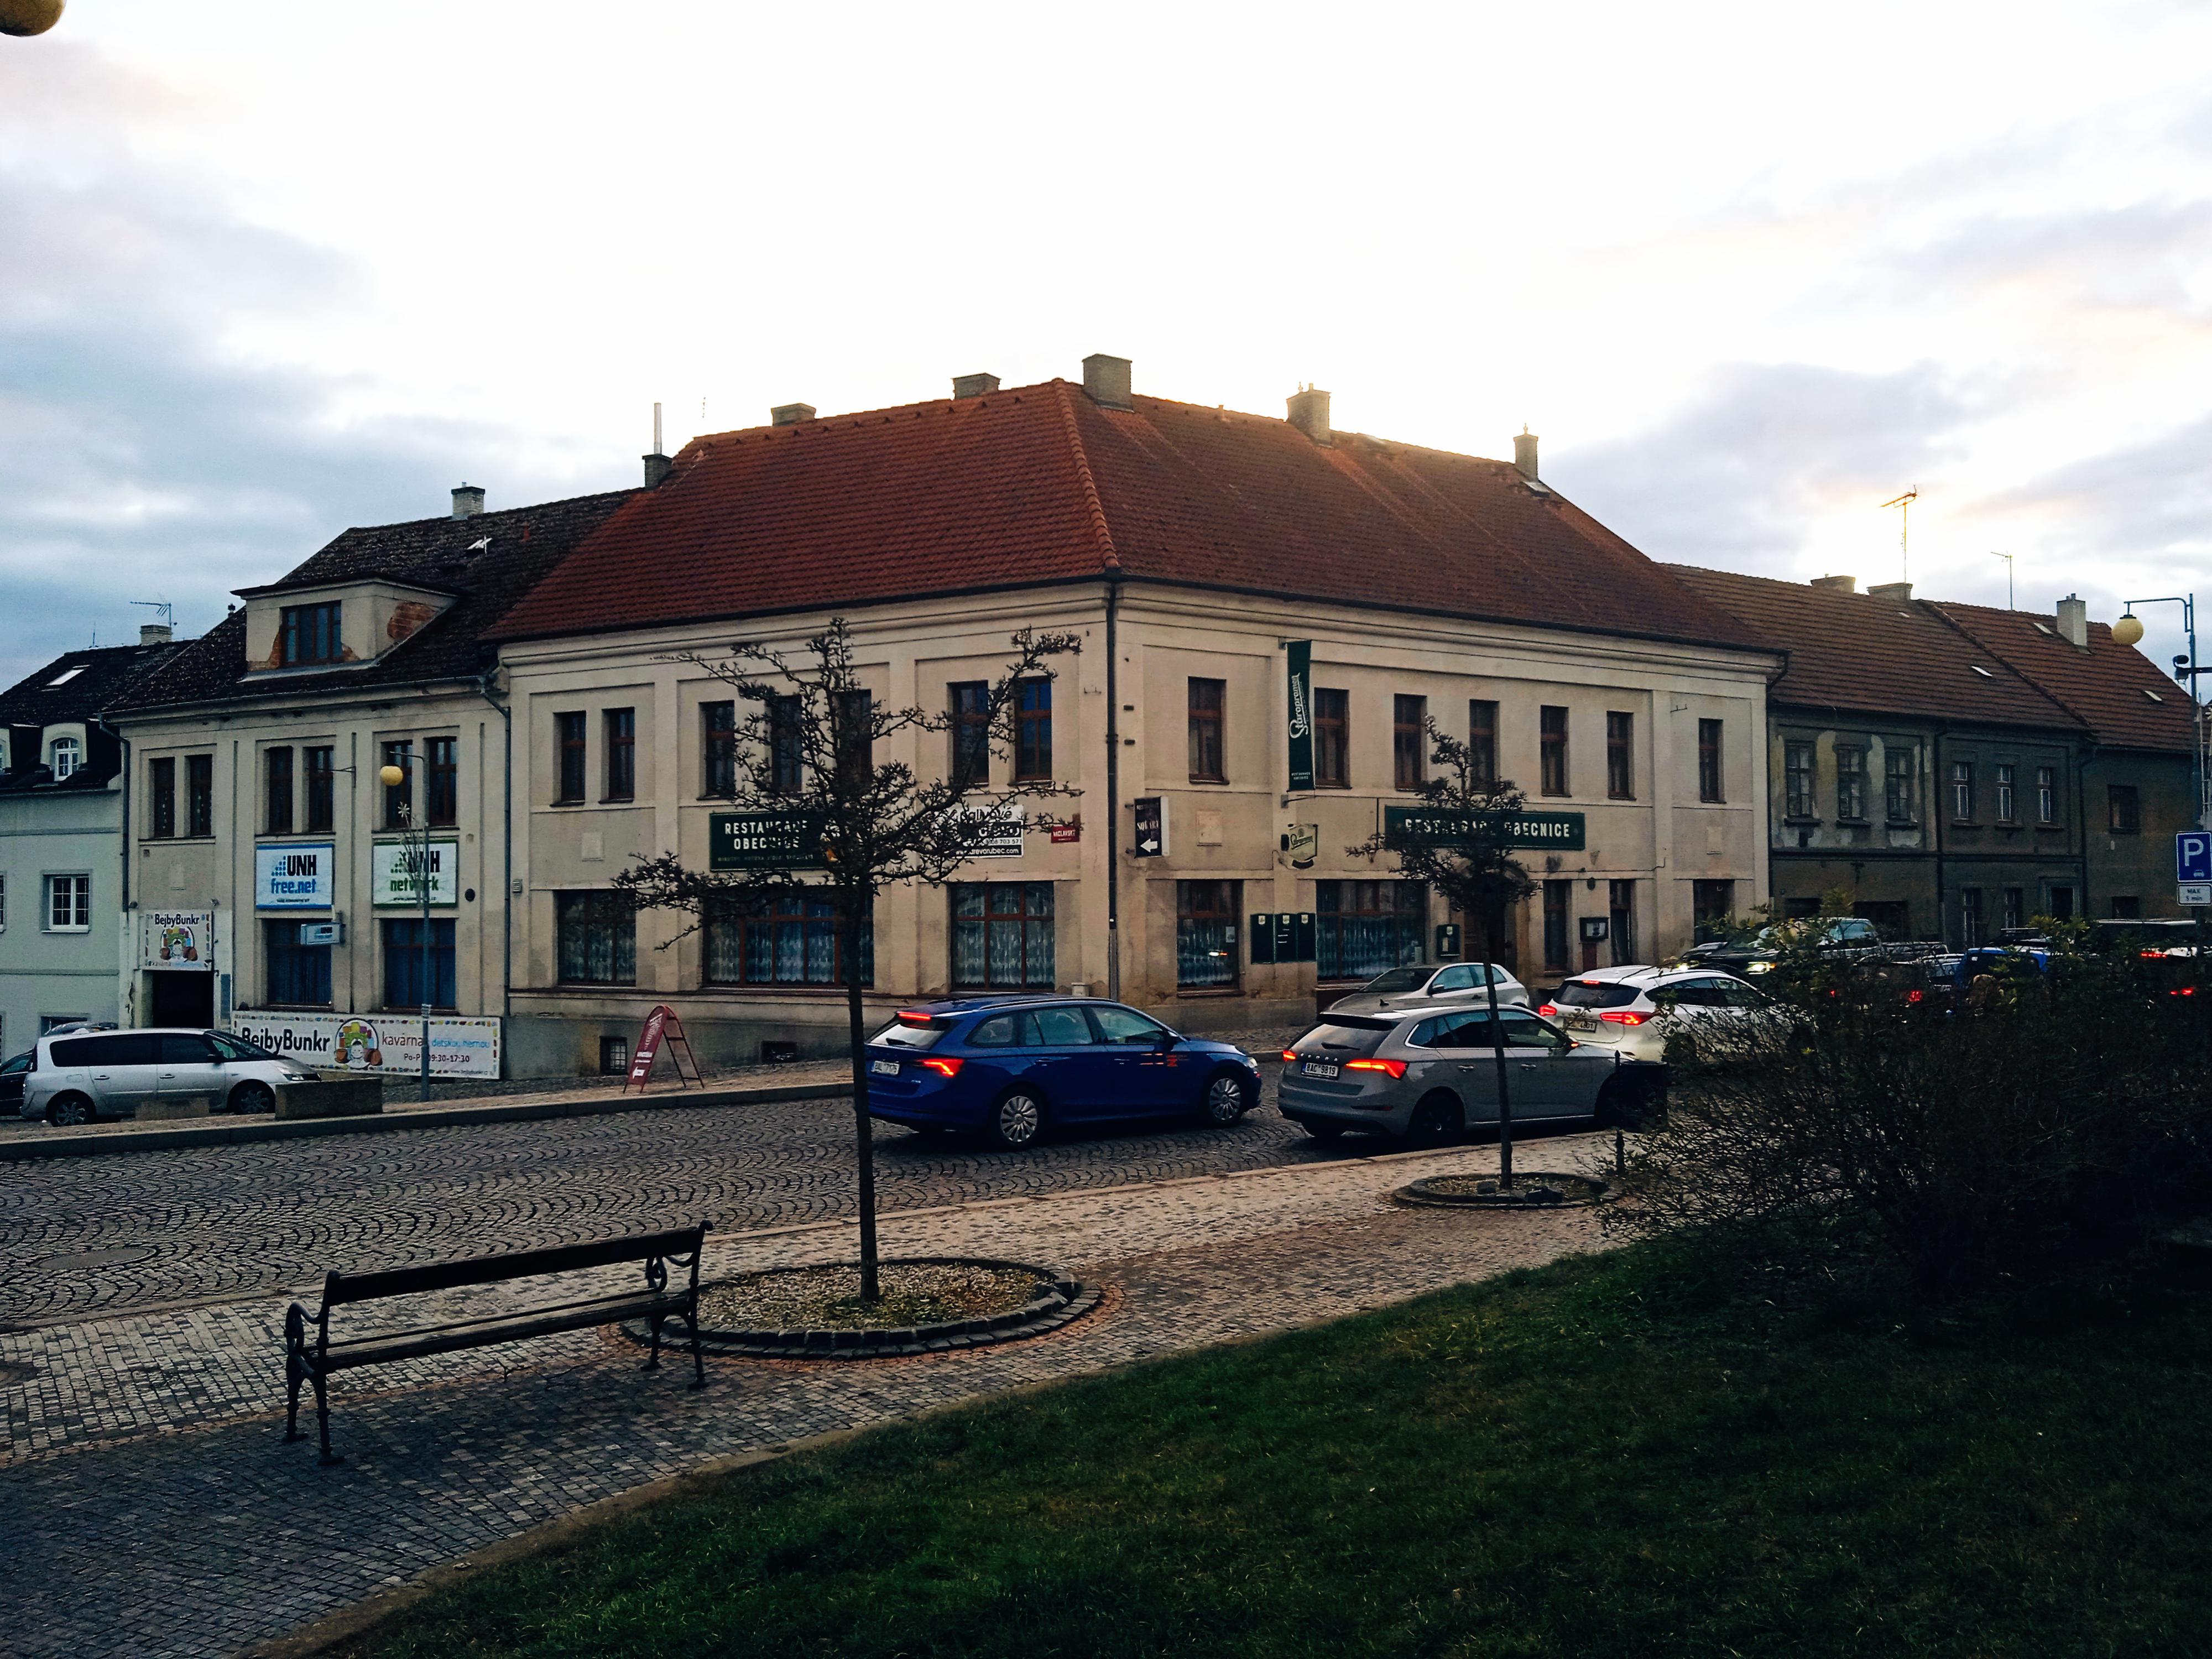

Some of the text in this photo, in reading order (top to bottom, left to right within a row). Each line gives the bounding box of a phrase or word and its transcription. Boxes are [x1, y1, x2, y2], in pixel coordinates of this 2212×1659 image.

[1289, 672, 1308, 738] Staropramen
[406, 851, 440, 873] UH
[2184, 839, 2204, 867] P
[287, 855, 317, 876] UNH
[271, 878, 316, 894] free.net
[155, 914, 199, 927] BejbyBunkr
